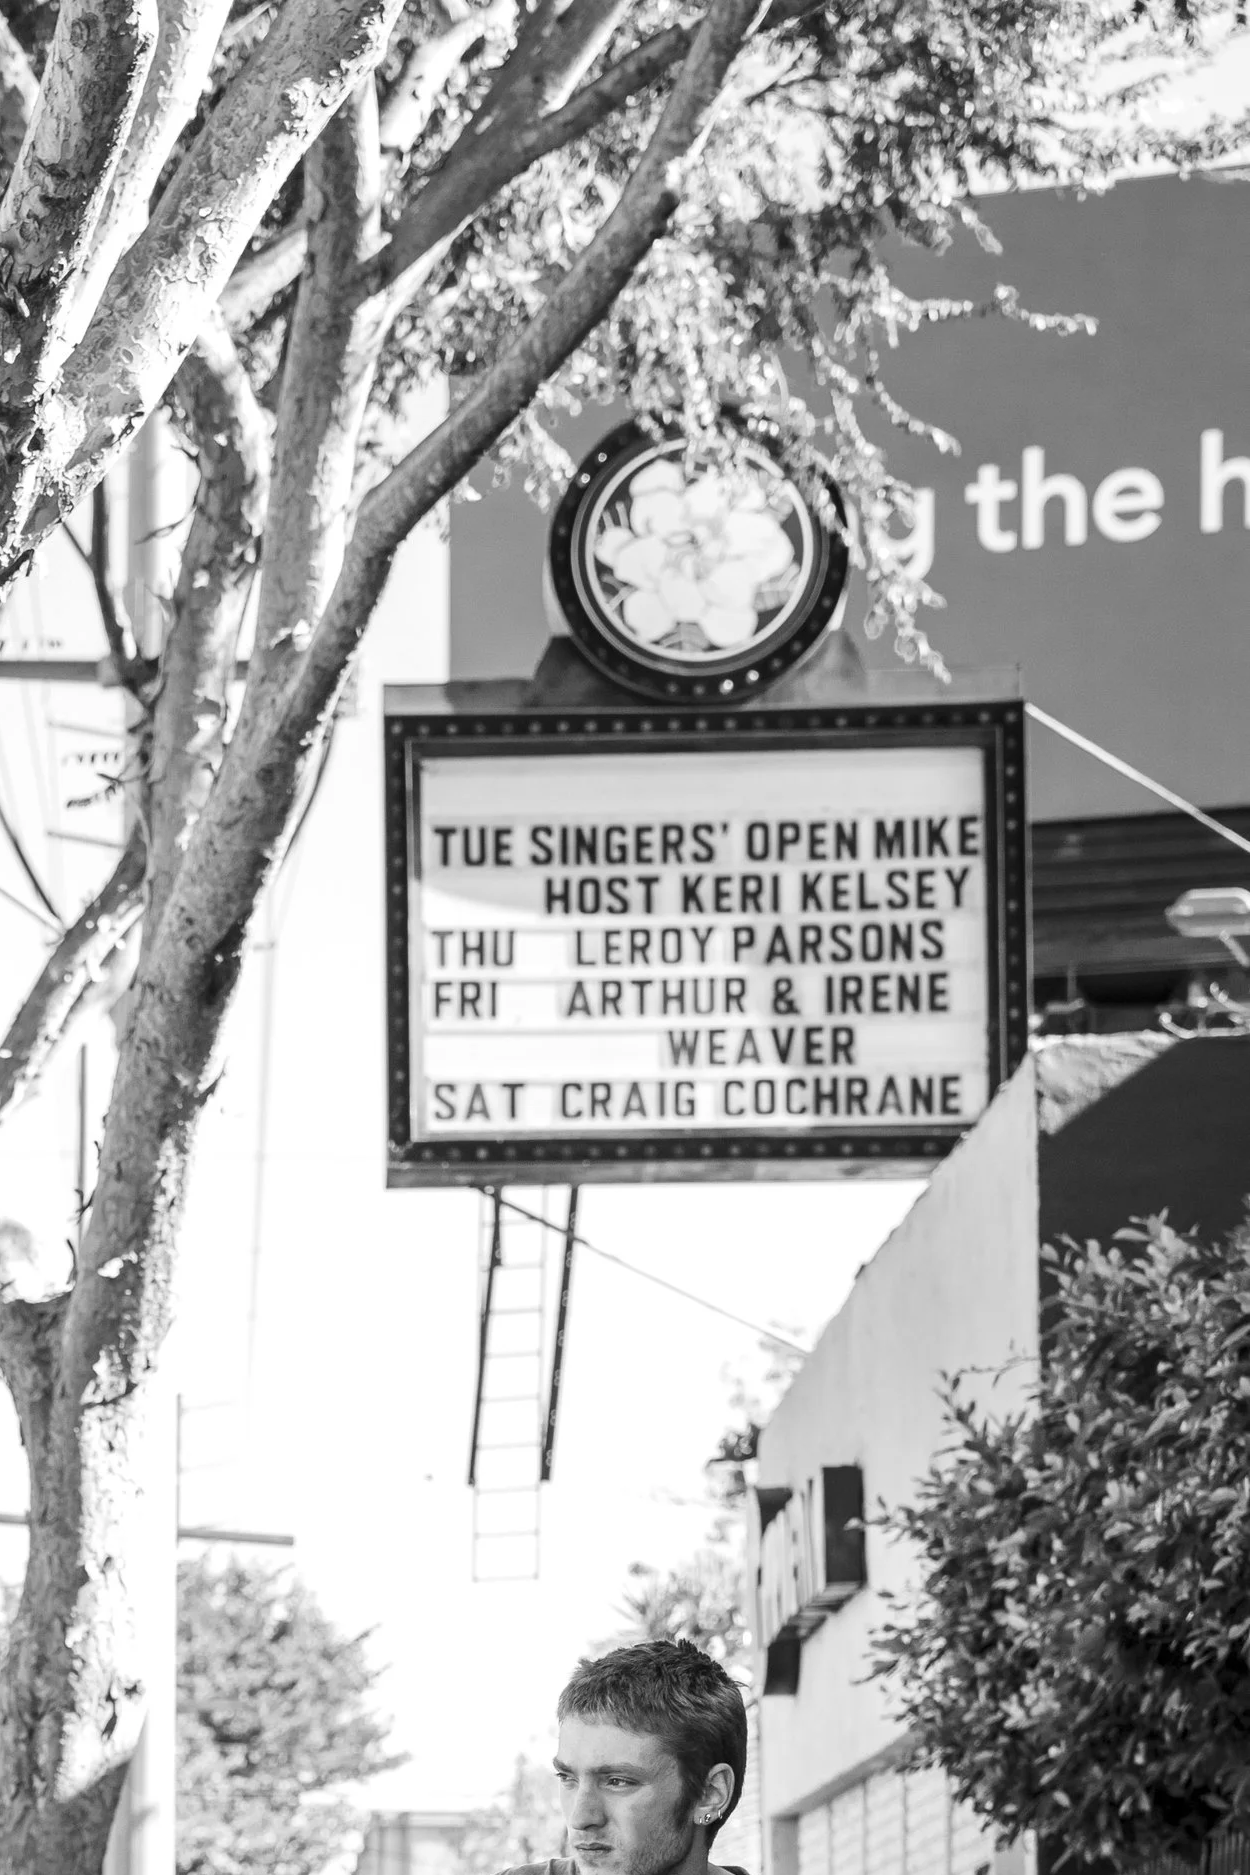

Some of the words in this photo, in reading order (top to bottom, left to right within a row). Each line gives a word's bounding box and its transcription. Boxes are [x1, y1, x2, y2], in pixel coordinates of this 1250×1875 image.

[964, 444, 1166, 553] the
[433, 825, 515, 867] TUE
[529, 820, 730, 866] SINGERS'
[745, 818, 857, 861] OPEN
[873, 815, 980, 859] MIKE
[545, 875, 659, 914] HOST
[681, 872, 780, 911] KERI
[800, 867, 971, 908] KELSEY
[432, 930, 515, 966] THU
[575, 926, 714, 965] LEROY
[732, 920, 944, 963] PARSONS
[433, 980, 499, 1018] FRI
[566, 977, 746, 1017] ARTHUR
[772, 976, 800, 1015] &
[825, 972, 950, 1013] IRENE
[668, 1026, 856, 1066] WEAVER
[433, 1082, 525, 1120] SAT
[561, 1079, 697, 1119] CRAIG
[722, 1076, 962, 1116] COCHRANE
